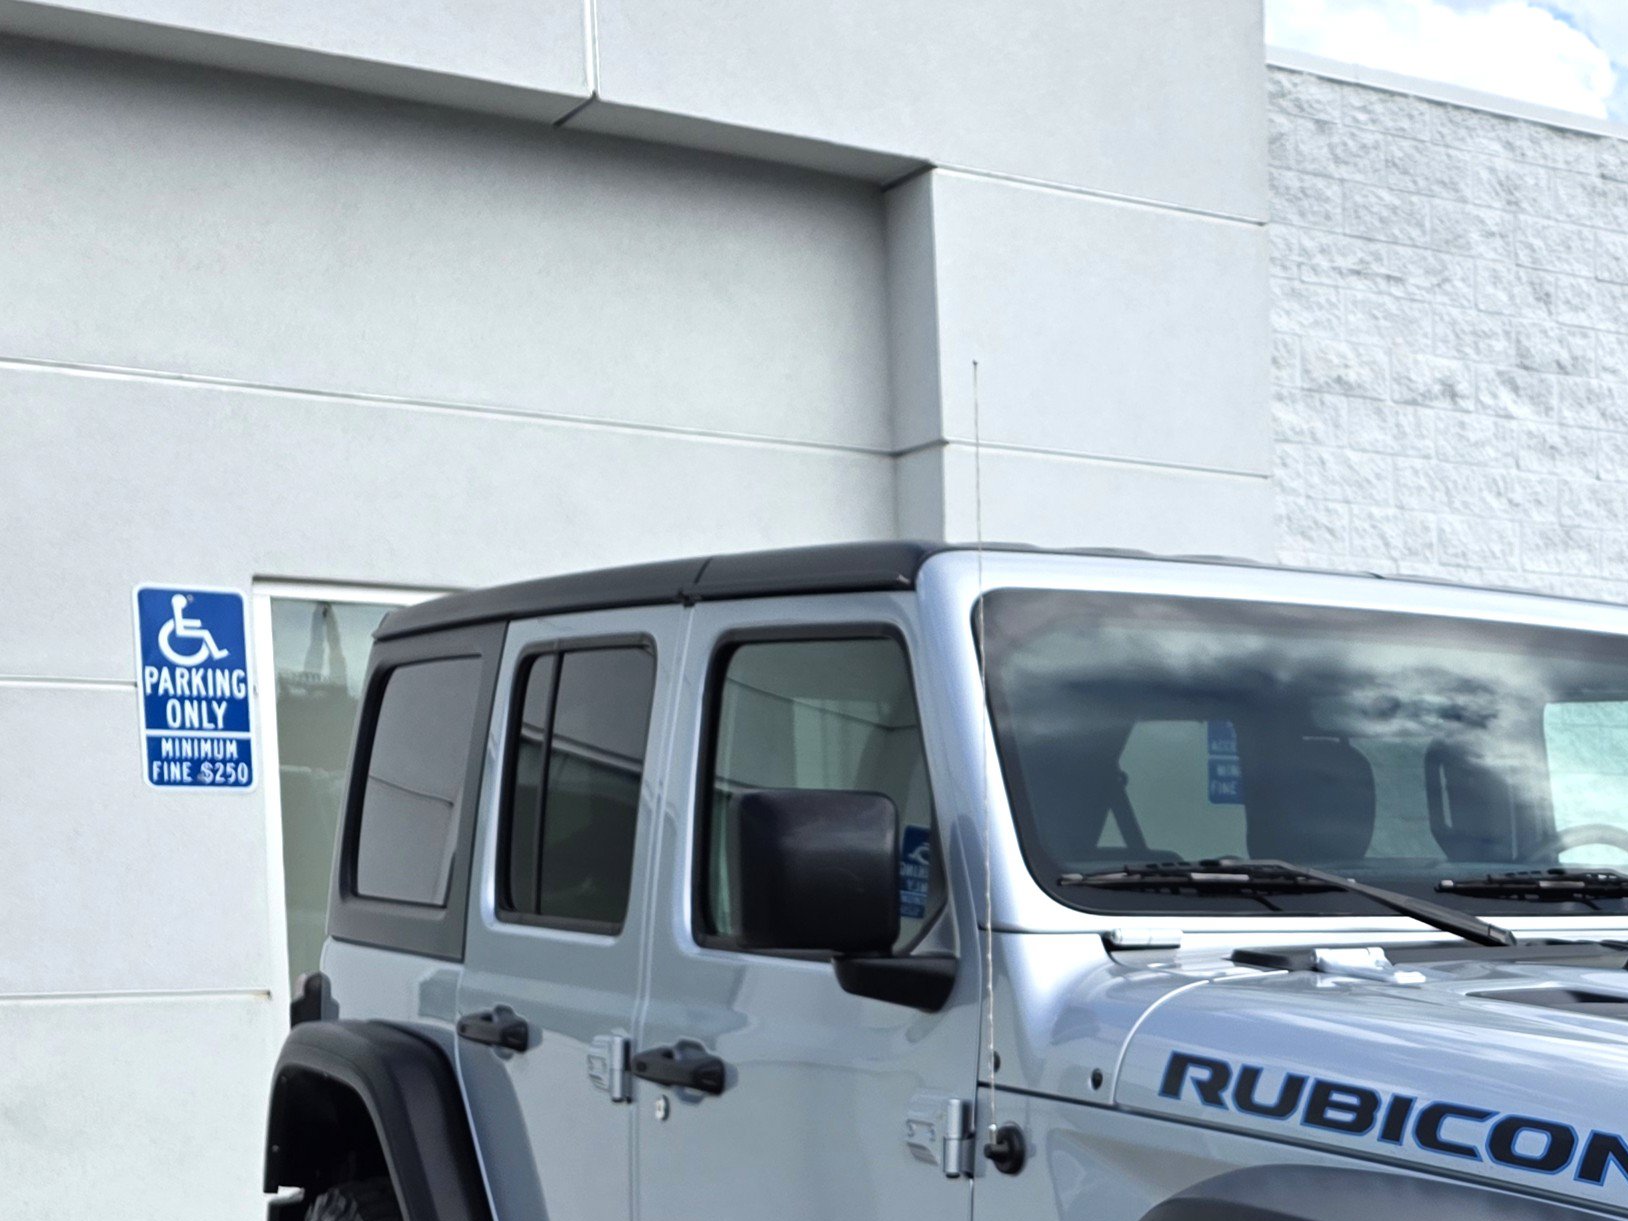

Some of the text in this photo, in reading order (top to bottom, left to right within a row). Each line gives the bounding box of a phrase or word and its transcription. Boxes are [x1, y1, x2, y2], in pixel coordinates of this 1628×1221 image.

[145, 666, 247, 699] PARKING
[166, 699, 228, 730] ONLY
[161, 737, 238, 760] MINIMUM
[152, 761, 249, 784] FINE $250
